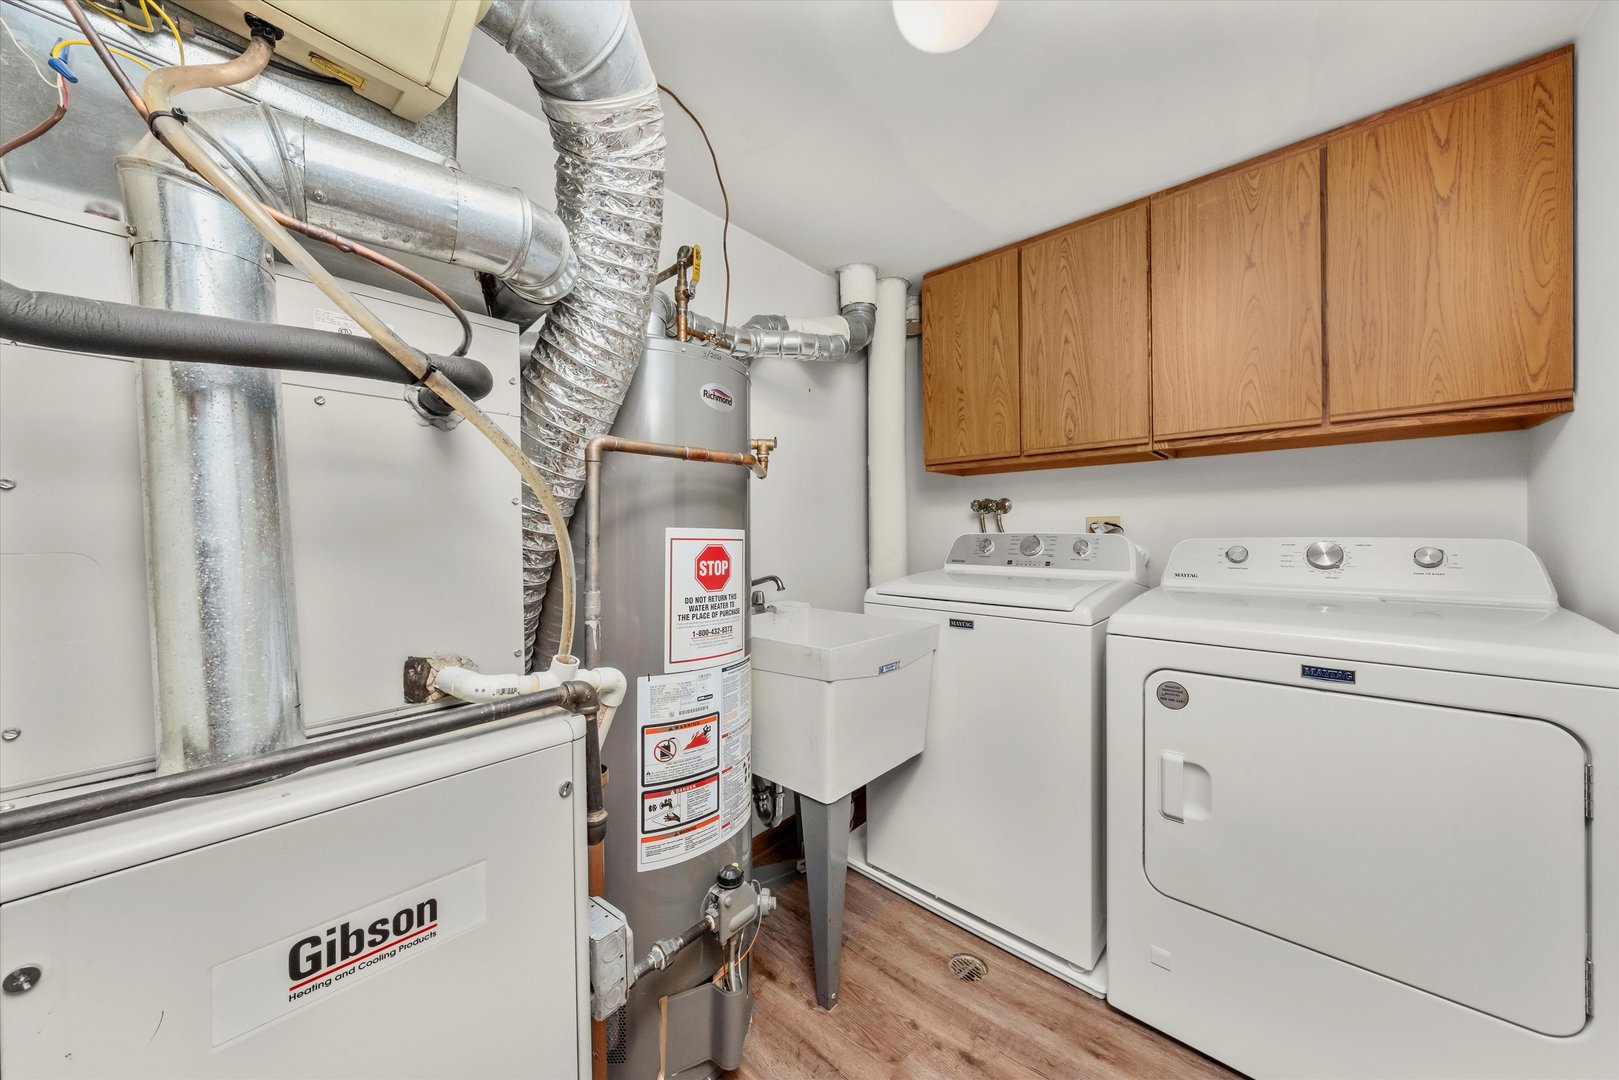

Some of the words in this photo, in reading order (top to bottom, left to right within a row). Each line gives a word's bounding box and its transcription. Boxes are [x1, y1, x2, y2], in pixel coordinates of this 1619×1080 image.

[703, 390, 732, 406] Richmond
[699, 560, 728, 577] STOP
[695, 596, 707, 604] NOT
[708, 594, 727, 602] RETURN
[689, 604, 709, 612] WATER
[710, 602, 729, 610] HEATER
[678, 613, 690, 621] THE
[692, 612, 710, 620] PLACE
[719, 608, 741, 617] PURCHASE
[950, 620, 974, 628] MAYTAG
[692, 625, 733, 637] 1-800-432-8373
[1303, 666, 1353, 681] MAYTAG
[674, 721, 700, 731] WARNING
[676, 784, 697, 794] DANGER
[288, 898, 438, 982] Gibson
[288, 976, 332, 1002] Heating
[334, 966, 356, 981] and
[358, 948, 396, 971] Cooling
[398, 930, 437, 953] Products
